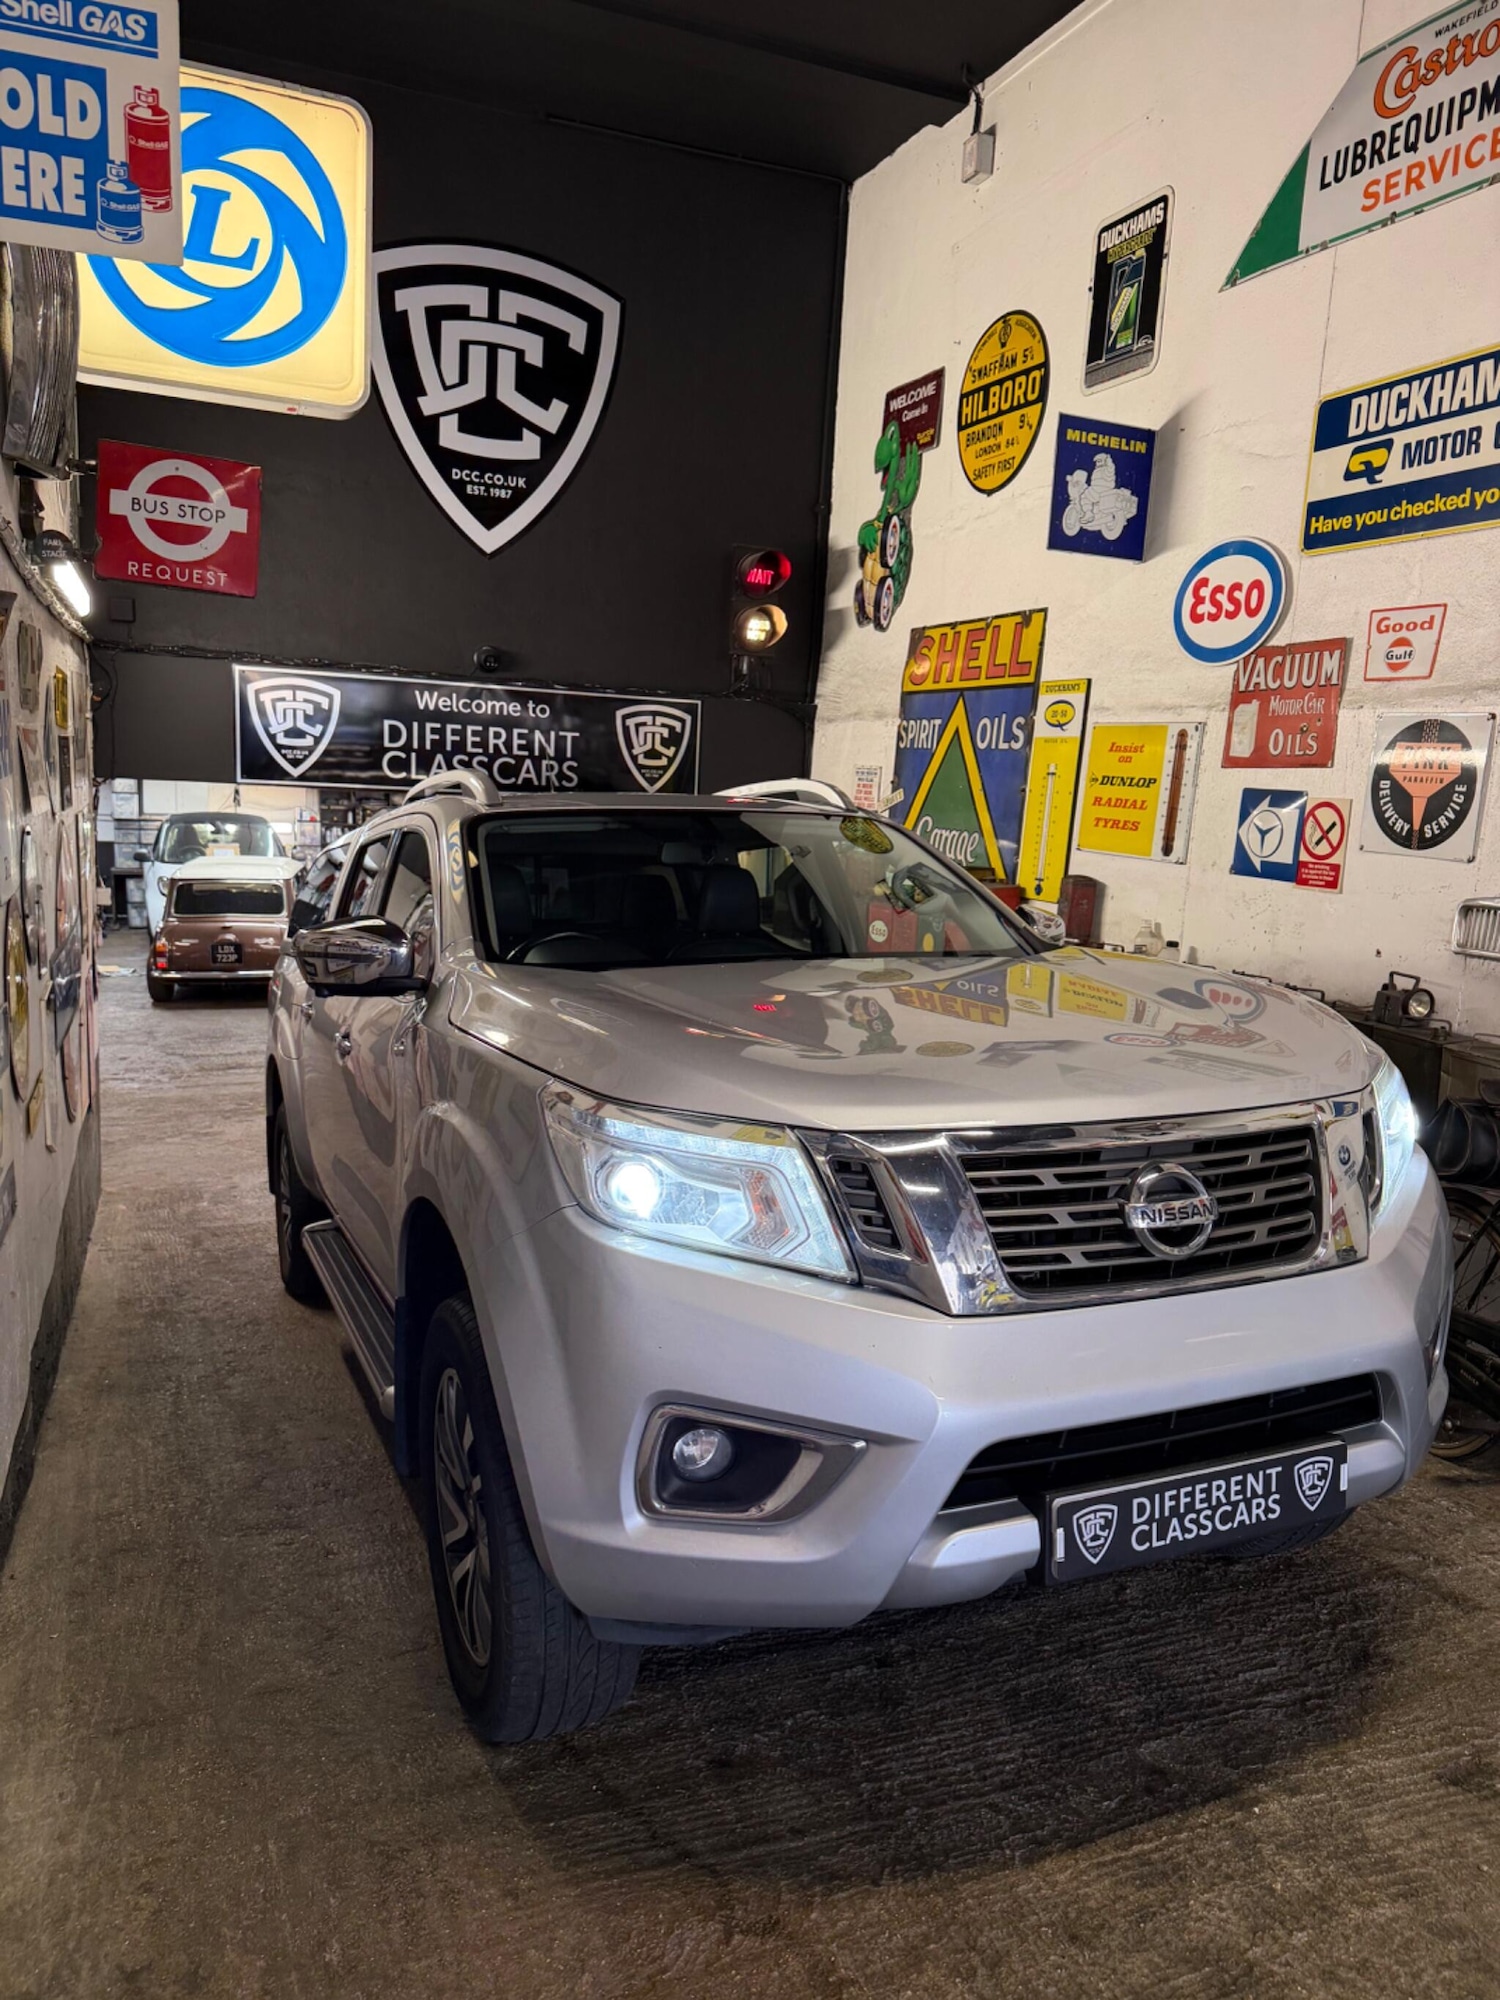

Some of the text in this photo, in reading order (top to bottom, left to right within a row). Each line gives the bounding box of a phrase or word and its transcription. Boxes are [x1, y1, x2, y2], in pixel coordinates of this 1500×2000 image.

[79, 5, 148, 41] GAS
[1434, 0, 1499, 39] WAKEFIELD
[1100, 202, 1165, 253] DUCKHAMS
[971, 352, 1018, 384] SWAFFHAM
[889, 381, 937, 412] WELCOME
[966, 421, 1004, 448] BRANDON
[1066, 428, 1147, 454] MICHELIN
[1401, 425, 1483, 470] MOTOR
[975, 442, 1001, 459] LONDON
[452, 468, 526, 488] DCC.CO.UK
[973, 456, 1016, 481] SAFETY FIRST
[466, 485, 512, 500] EST. 1987
[131, 497, 226, 524] BUS STOP
[1309, 515, 1352, 535] Have
[1355, 506, 1388, 531] you
[1390, 487, 1471, 522] checked
[128, 561, 228, 587] REQUEST
[1376, 614, 1436, 635] Good
[909, 622, 1032, 686] SHELL
[1385, 649, 1415, 662] Gulf
[1238, 649, 1342, 693] VACUUM
[414, 689, 551, 719] Welcome to
[383, 719, 580, 759] DIFFERENT
[899, 713, 1026, 753] SPIRIT OILS
[1108, 742, 1145, 754] Insist
[1117, 755, 1132, 764] on
[382, 750, 579, 788] CLASSCARS
[1099, 775, 1157, 789] DUNLOP
[1403, 776, 1445, 784] PARAFFIN
[1092, 796, 1148, 811] RADIAL
[1378, 779, 1468, 839] DELIVERY SERVICE
[1093, 817, 1140, 832] TYRES
[1140, 1202, 1214, 1223] NISSAN
[1132, 1466, 1283, 1525] DIFFERENT
[1131, 1493, 1282, 1552] CLASSCARS
